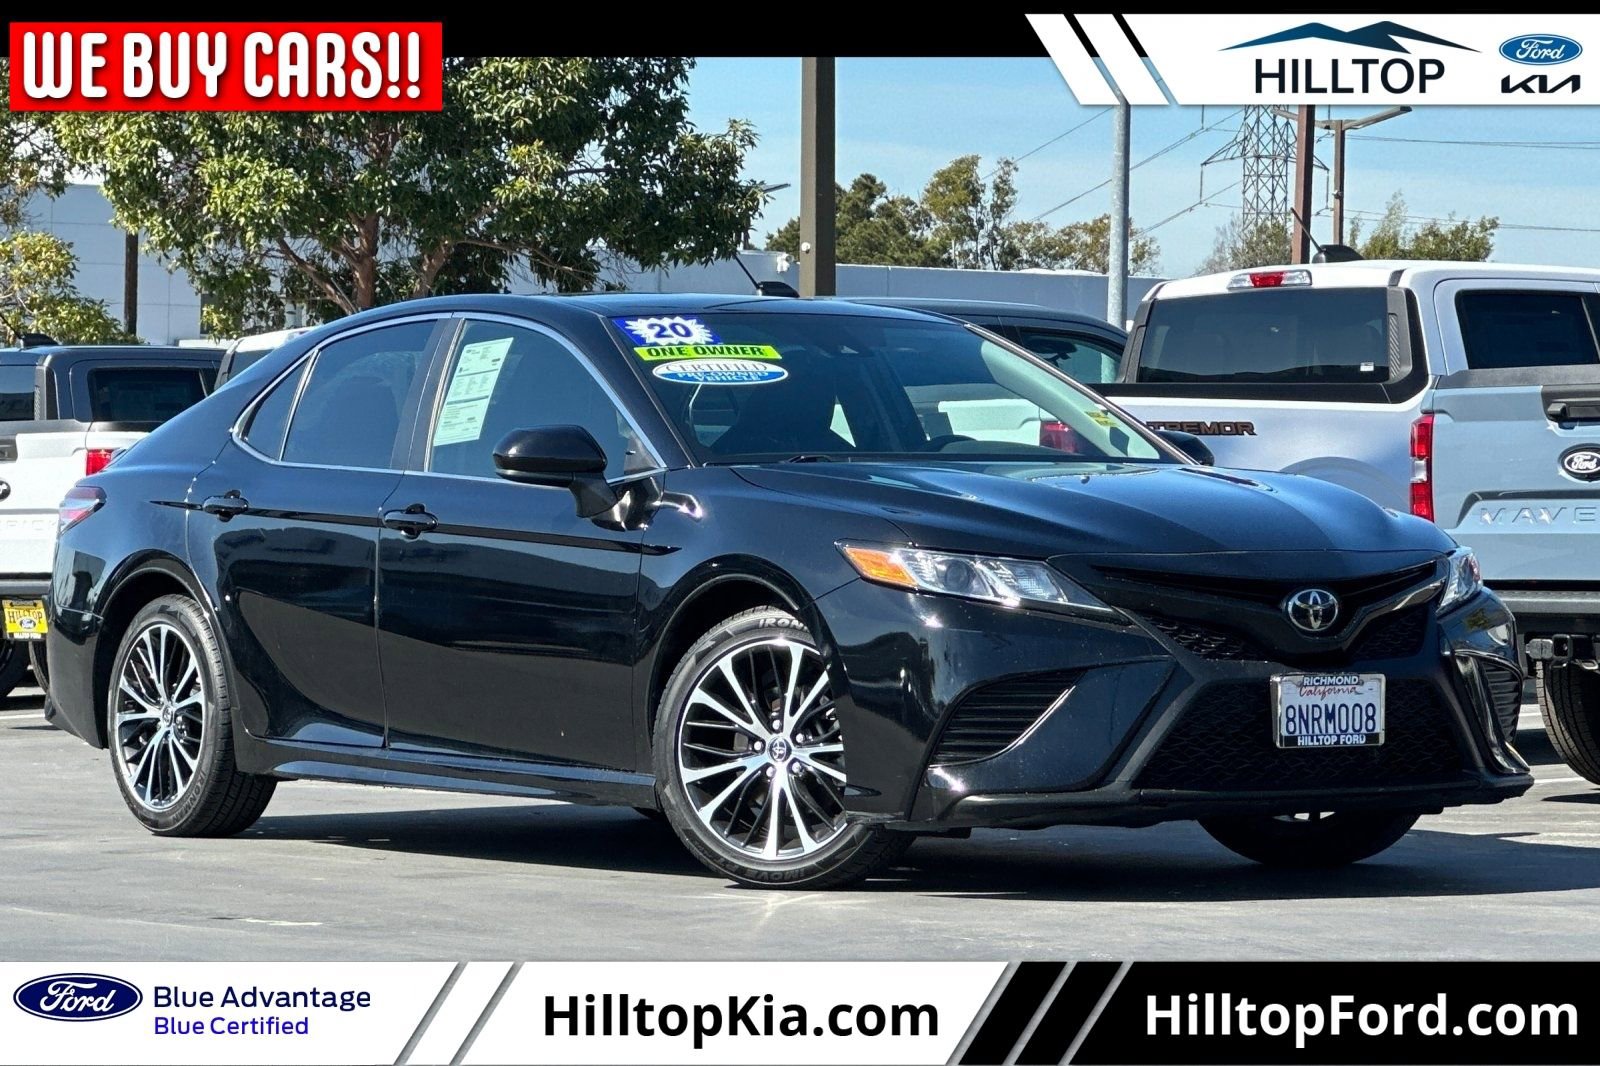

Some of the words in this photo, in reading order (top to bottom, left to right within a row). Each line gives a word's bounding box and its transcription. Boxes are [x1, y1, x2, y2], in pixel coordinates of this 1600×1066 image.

[647, 322, 693, 339] 20
[645, 346, 688, 357] ONE
[694, 345, 764, 357] OWNER
[1146, 421, 1258, 436] TREMOR
[1571, 454, 1598, 470] Ford
[1303, 675, 1359, 686] RICHMOND
[1299, 686, 1364, 701] California
[1285, 702, 1377, 734] 8NRM008
[1297, 735, 1338, 746] HILLTOP
[1340, 734, 1367, 745] FORD
